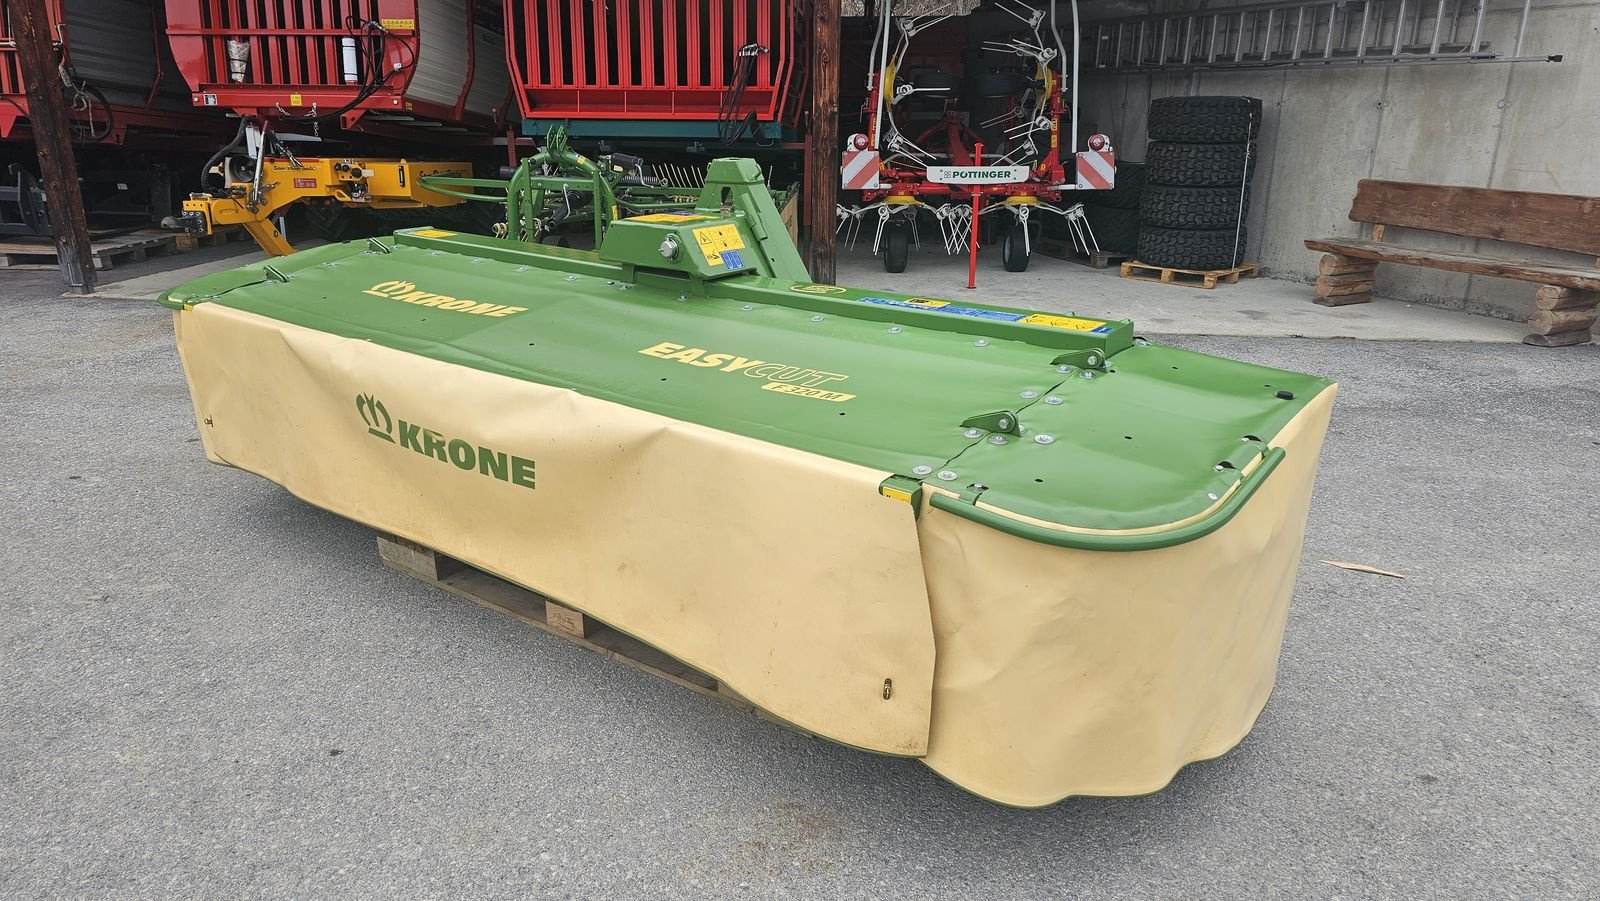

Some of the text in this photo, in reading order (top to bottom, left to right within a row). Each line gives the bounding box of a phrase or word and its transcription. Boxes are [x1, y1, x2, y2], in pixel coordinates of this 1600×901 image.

[390, 290, 529, 317] KRONE
[784, 386, 820, 396] 320
[820, 392, 843, 400] M
[398, 419, 536, 490] KRONE
